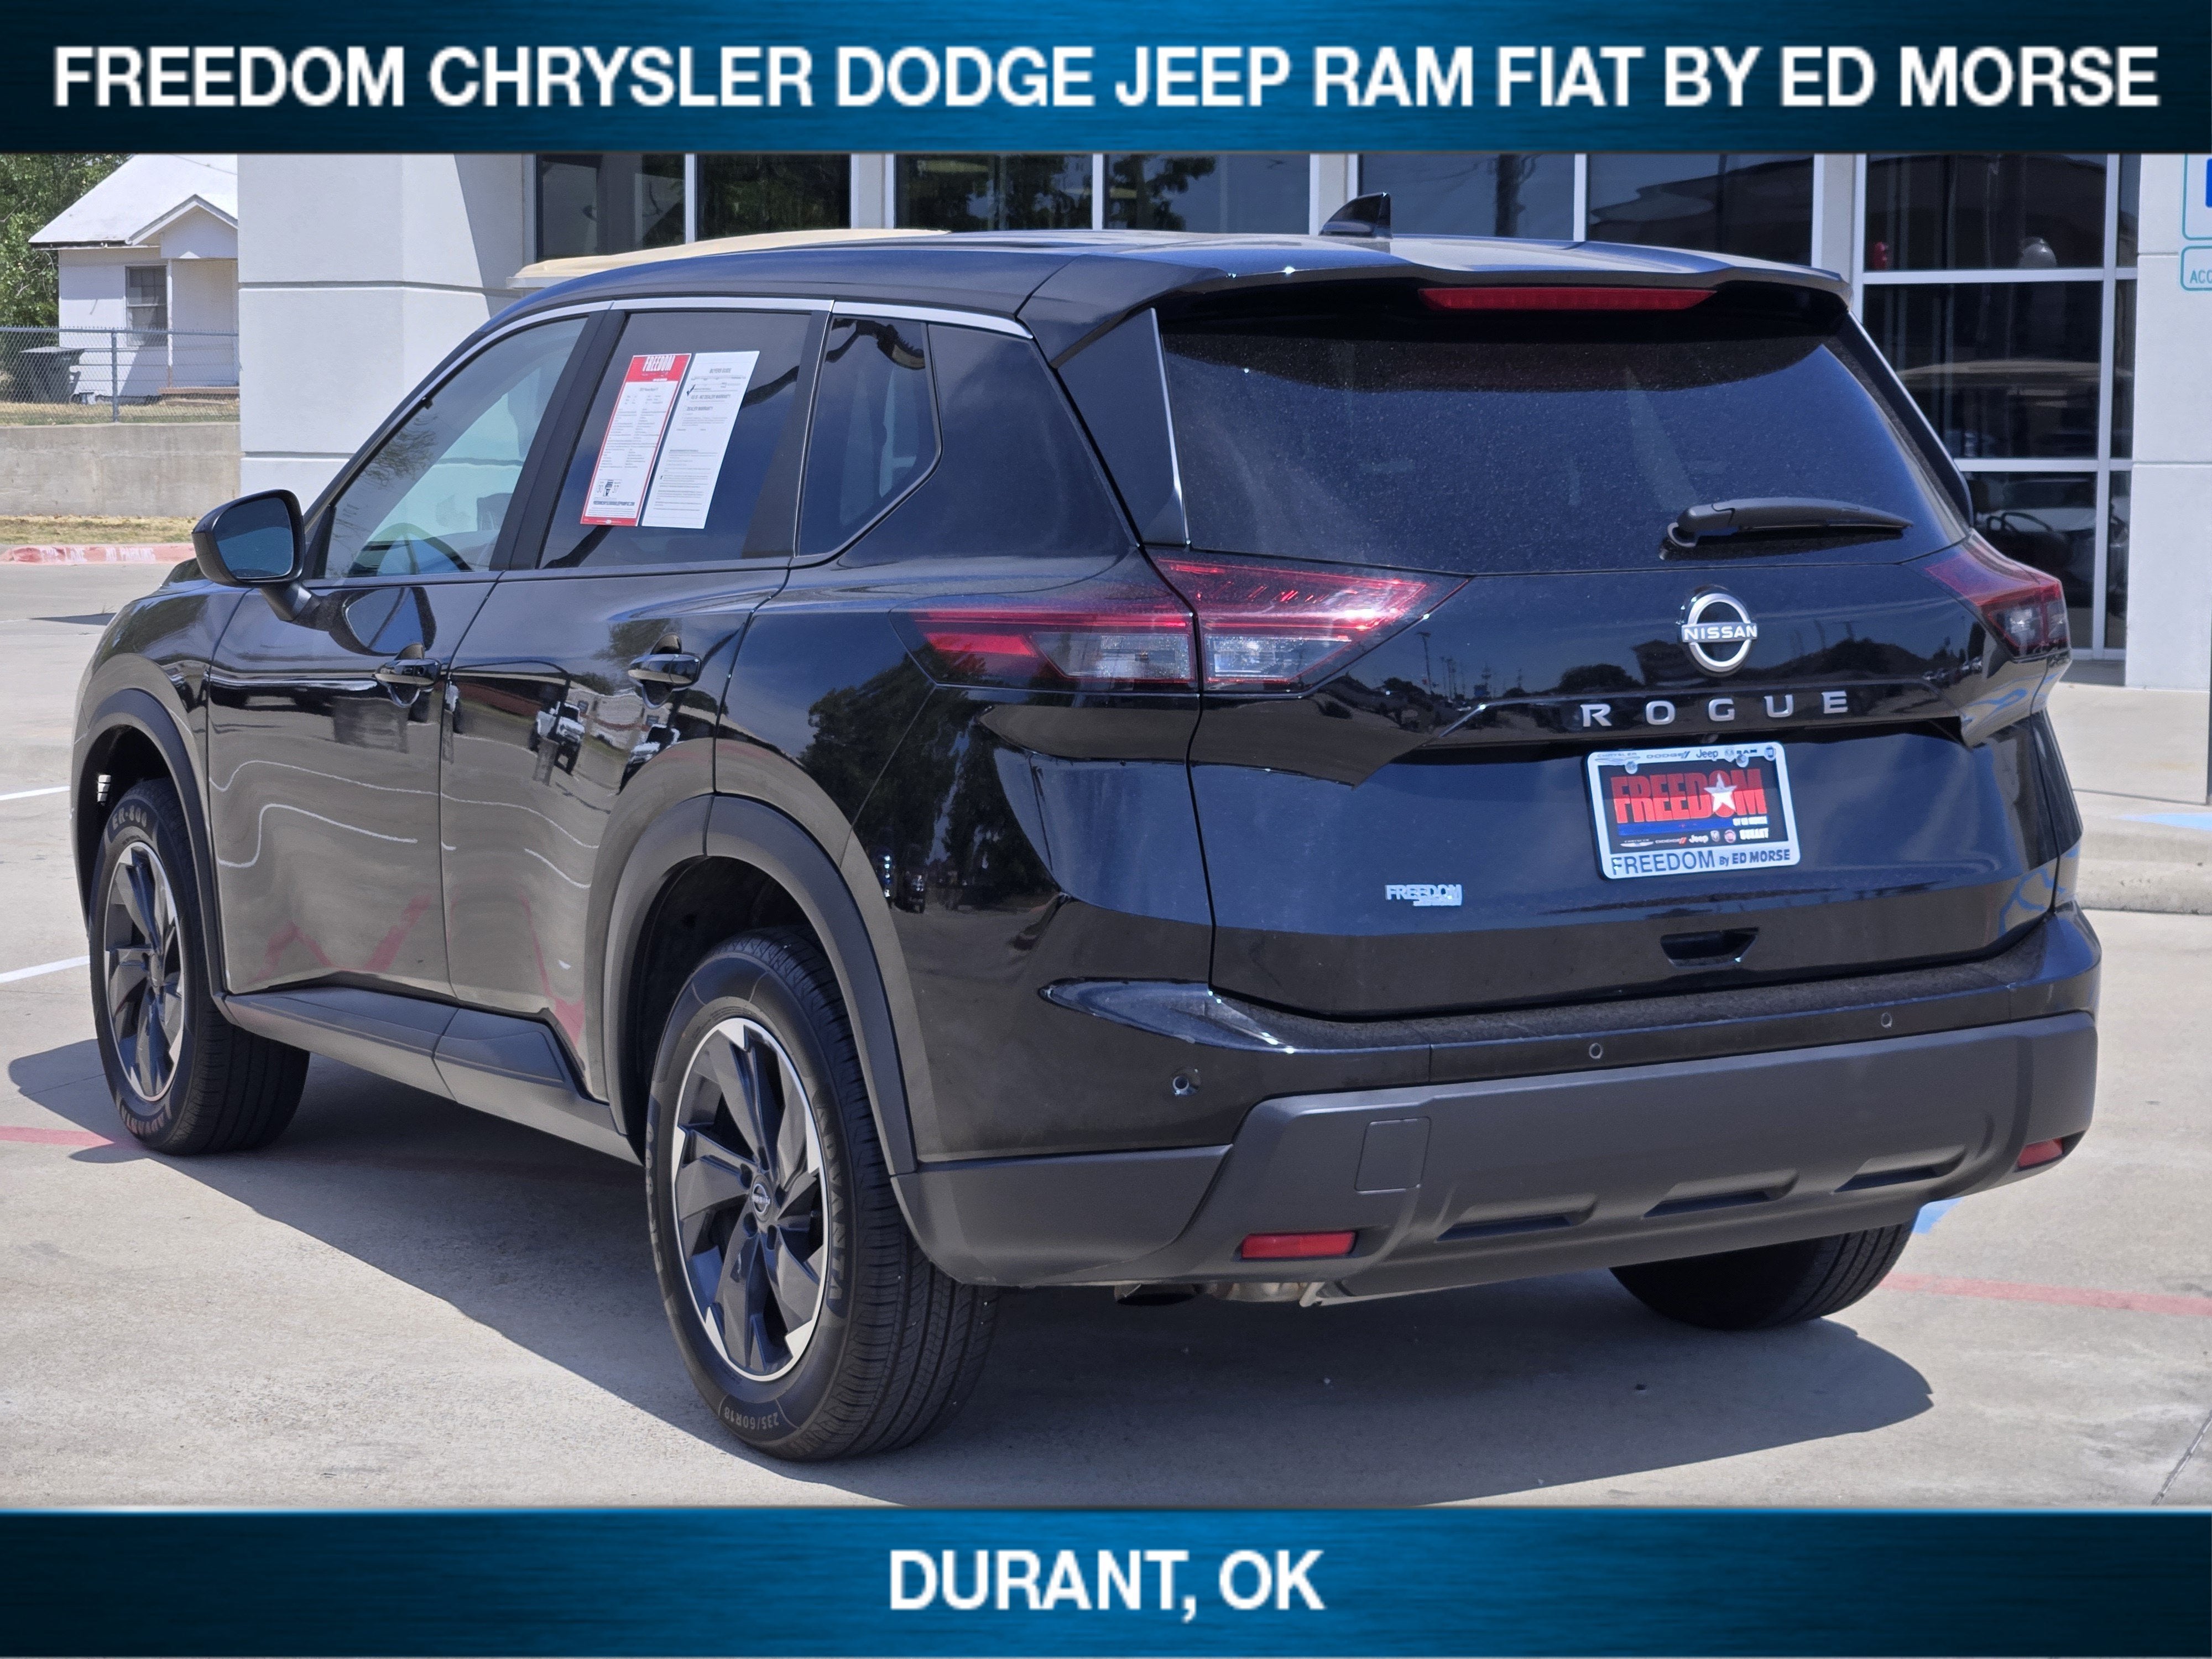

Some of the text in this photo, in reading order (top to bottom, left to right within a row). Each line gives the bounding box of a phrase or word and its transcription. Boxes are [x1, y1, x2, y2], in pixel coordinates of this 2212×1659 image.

[642, 355, 676, 372] FREEDOM
[1683, 624, 1757, 640] NISSAN
[1580, 690, 1849, 728] ROGUE
[1695, 749, 1719, 760] Jeep
[1610, 768, 1767, 824] FREEDOM
[1610, 850, 1715, 875] FREEDOM
[1732, 852, 1747, 864] ED
[1749, 849, 1791, 863] MORSE
[1385, 884, 1462, 900] FREEDOM
[724, 1406, 780, 1431] 235/60R18
